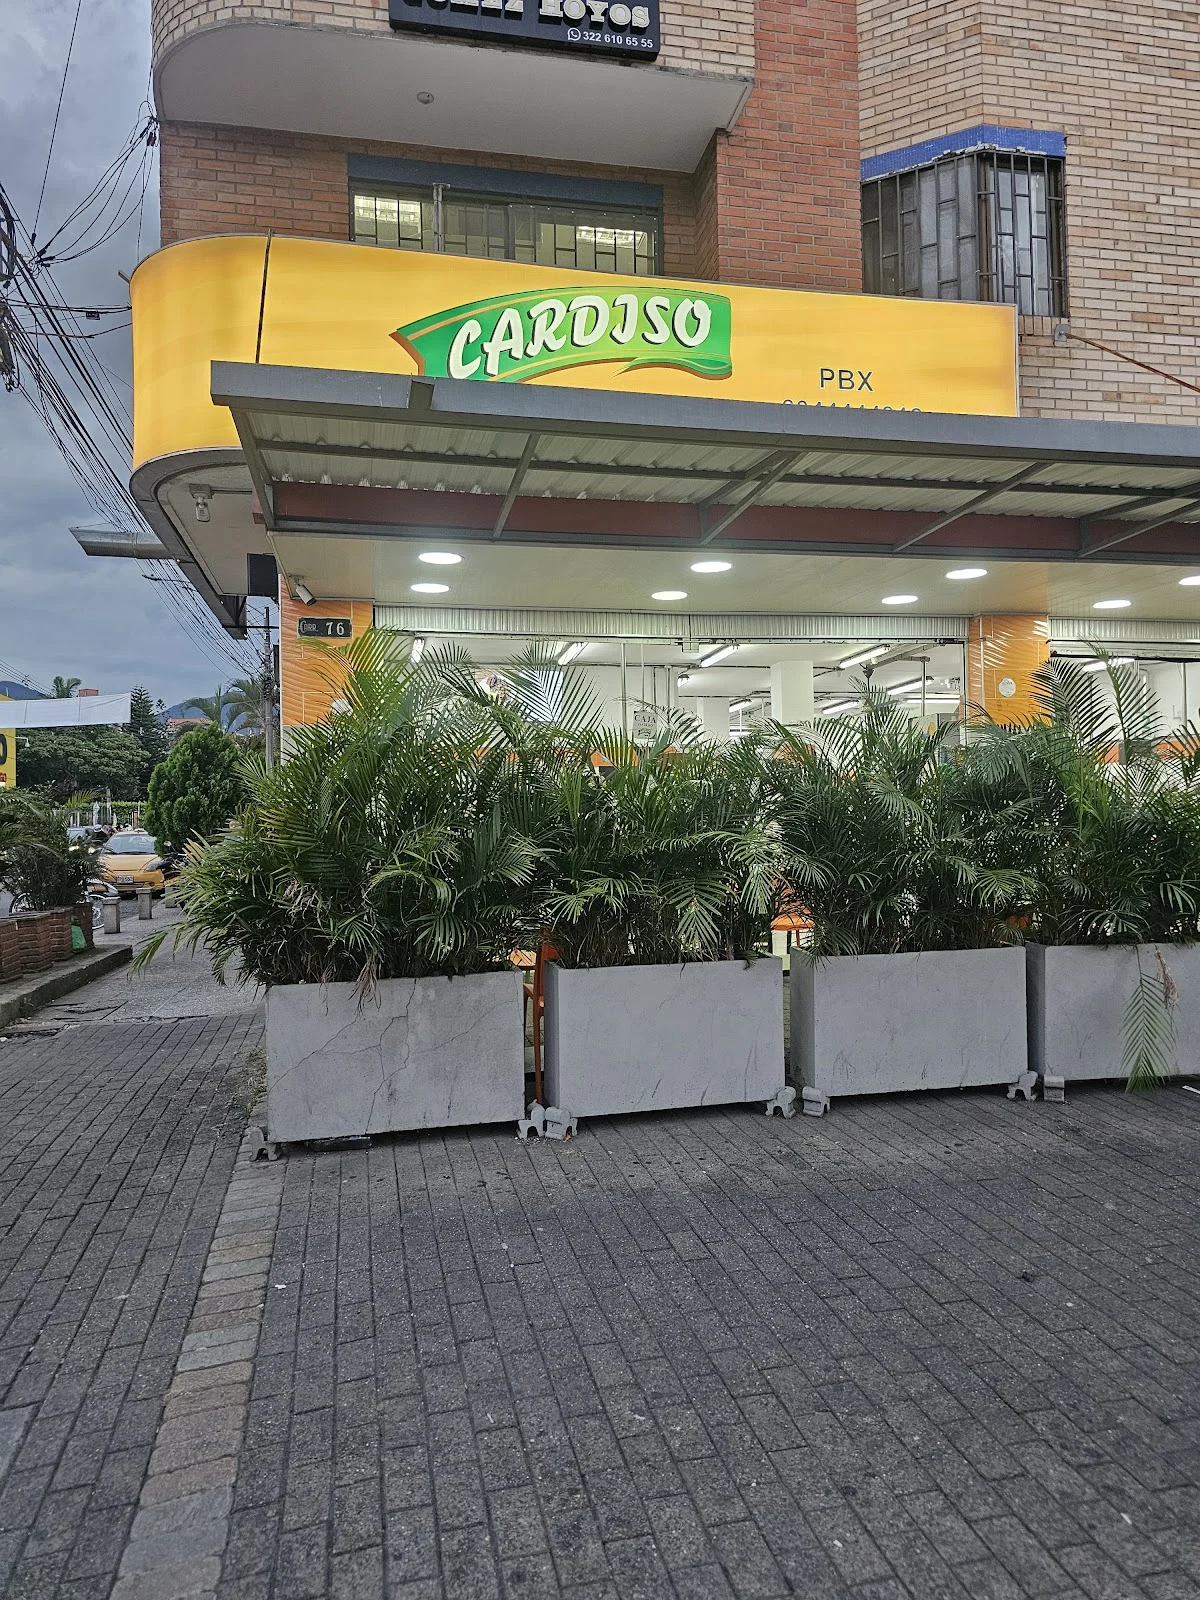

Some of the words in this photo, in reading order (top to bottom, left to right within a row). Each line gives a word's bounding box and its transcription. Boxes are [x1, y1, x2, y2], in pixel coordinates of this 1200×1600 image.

[539, 0, 650, 28] HOYOS
[583, 31, 601, 42] 322
[604, 34, 623, 45] 610
[625, 36, 638, 46] 65
[641, 38, 653, 48] 55
[449, 294, 712, 379] CARDISO
[820, 368, 874, 391] PBX
[326, 622, 345, 635] 76
